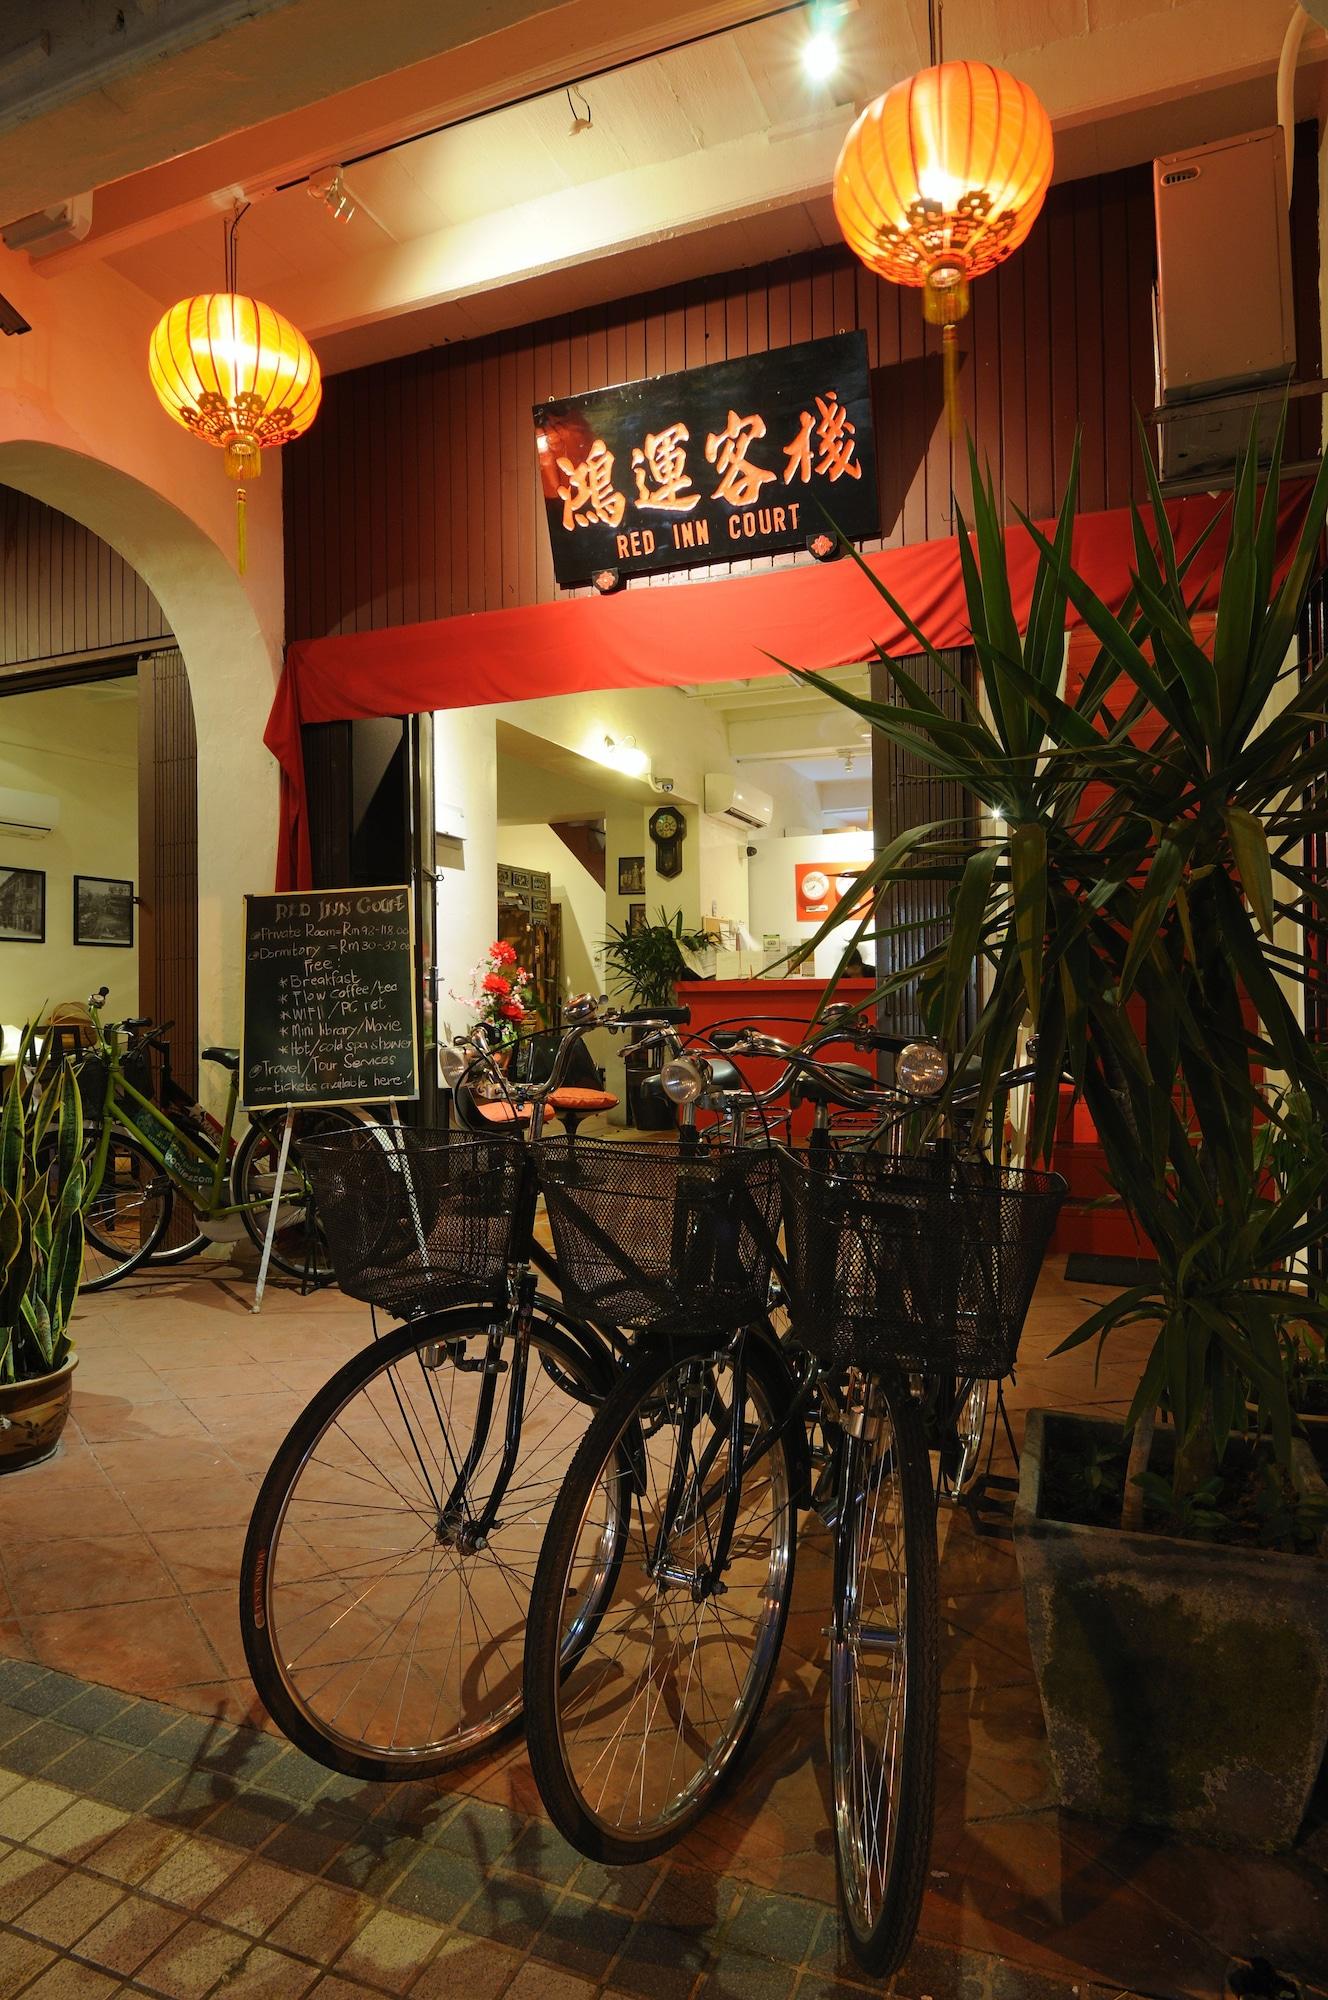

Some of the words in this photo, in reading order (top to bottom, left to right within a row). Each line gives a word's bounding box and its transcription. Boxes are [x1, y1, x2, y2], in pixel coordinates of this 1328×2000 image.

[555, 390, 862, 532] 鴻運客棧
[616, 529, 656, 560] RED
[672, 519, 710, 550] INN
[728, 503, 801, 541] COURT
[261, 924, 302, 941] Private
[260, 942, 321, 960] Dormitory
[290, 969, 361, 988] Breakfast
[292, 1022, 314, 1038] Mini
[345, 1040, 369, 1054] spa
[343, 1053, 397, 1069] Services
